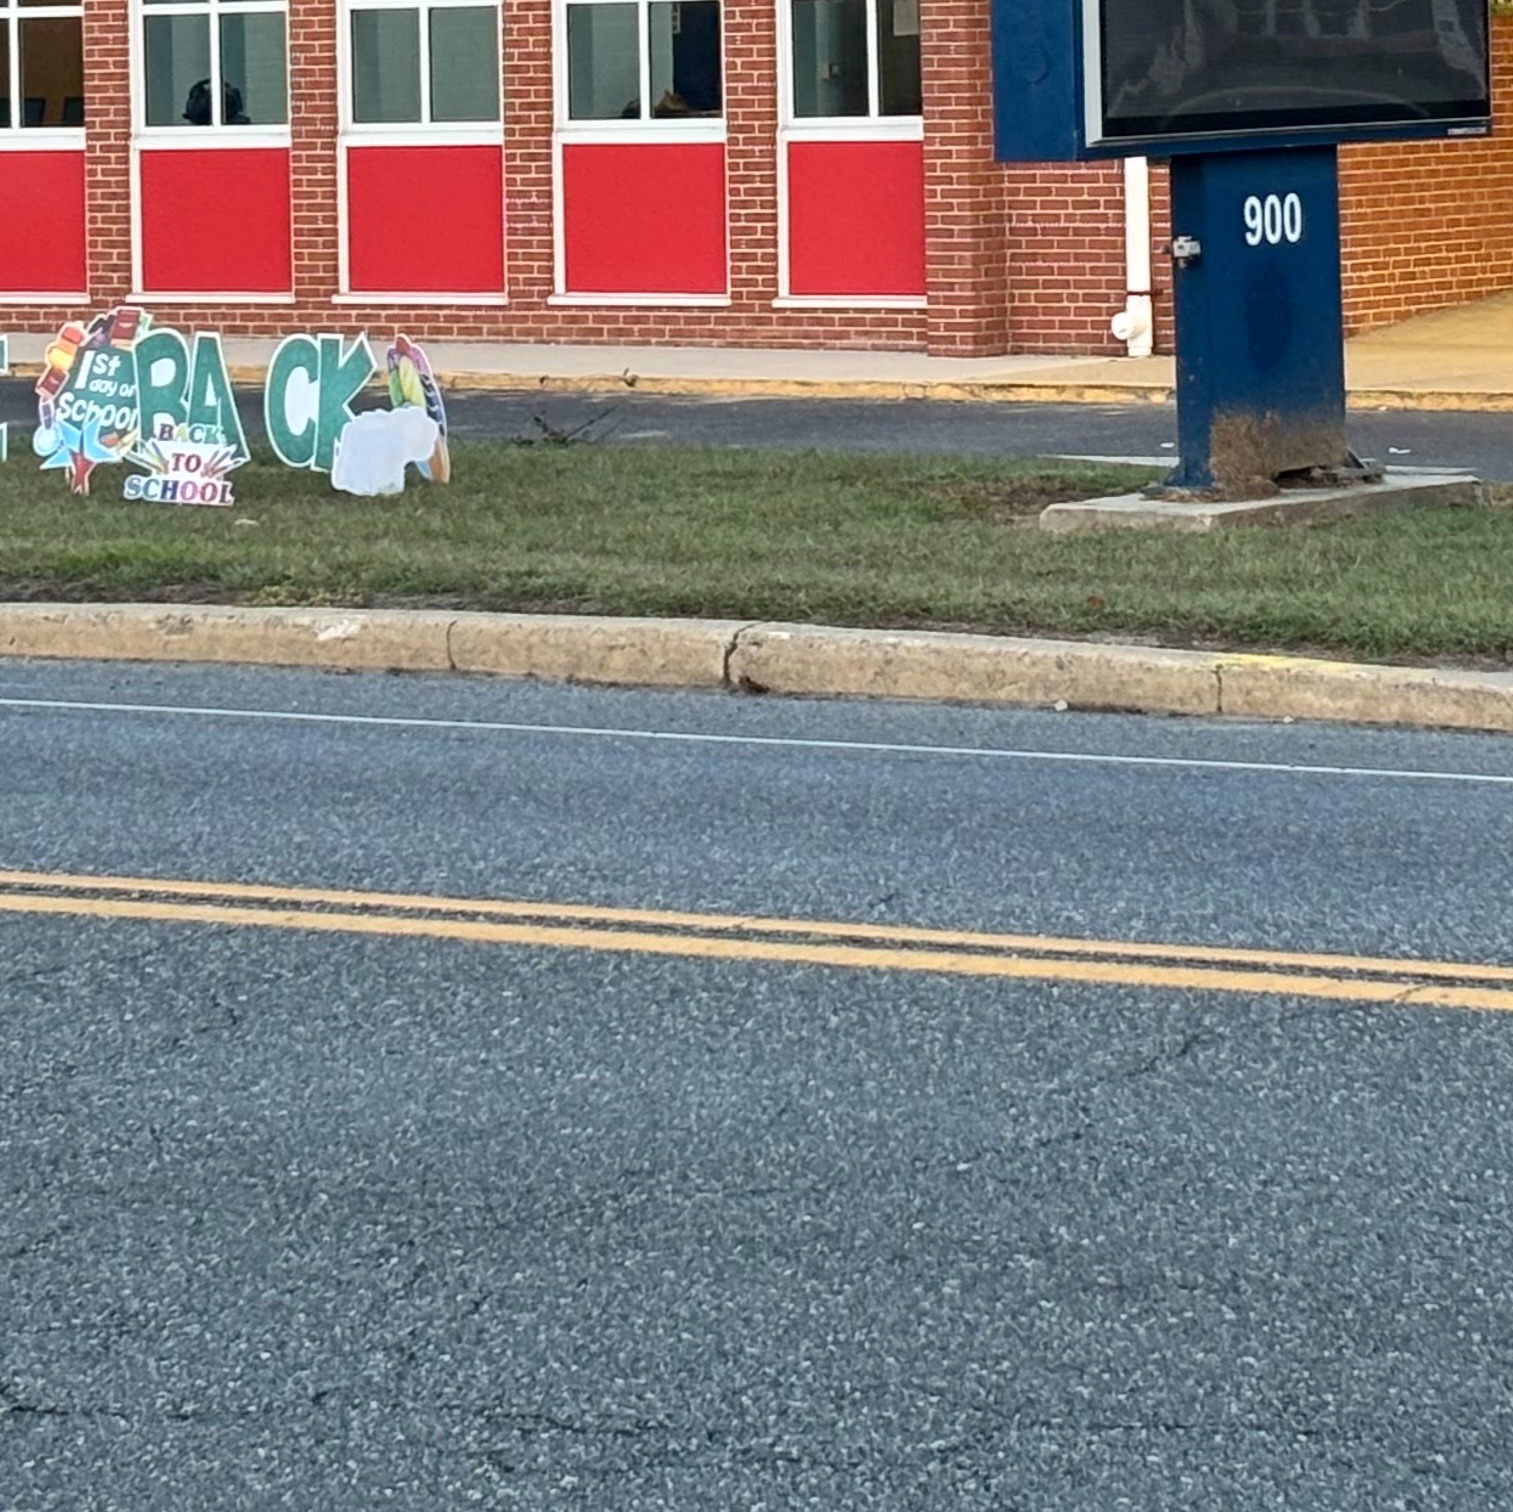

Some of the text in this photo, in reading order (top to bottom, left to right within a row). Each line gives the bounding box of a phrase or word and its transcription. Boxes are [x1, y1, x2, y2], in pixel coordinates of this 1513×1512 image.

[1243, 192, 1302, 246] 900
[158, 423, 222, 445] BACK
[171, 452, 202, 474] TO
[126, 476, 234, 504] SCHOOL
